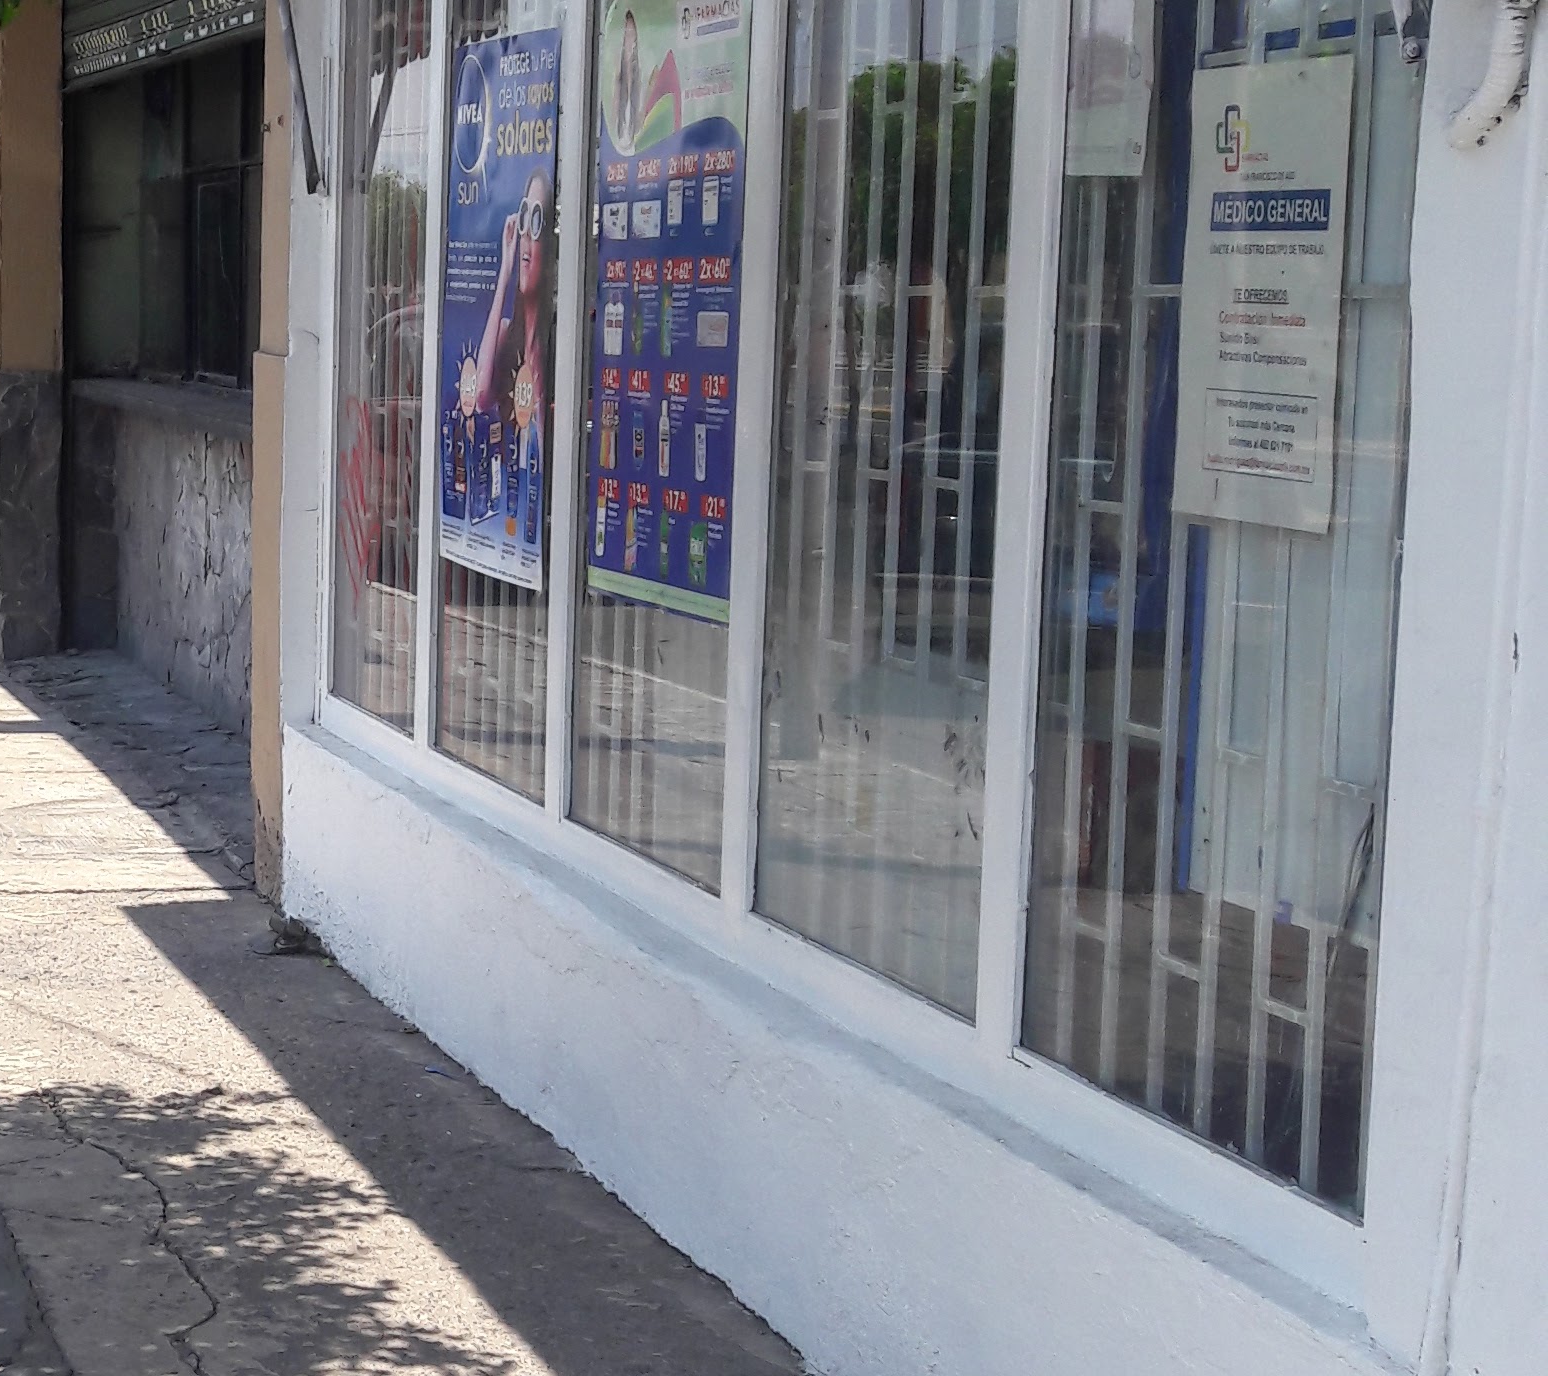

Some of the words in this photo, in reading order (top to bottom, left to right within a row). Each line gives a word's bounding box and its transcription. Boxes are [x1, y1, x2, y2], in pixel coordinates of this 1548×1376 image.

[499, 51, 531, 77] PROTEGE
[540, 48, 557, 70] Piel
[498, 82, 511, 109] de
[513, 80, 527, 107] los
[527, 80, 555, 111] rayos
[457, 101, 484, 125] NIVEA
[496, 110, 554, 158] solares
[457, 180, 480, 205] sun
[1213, 195, 1265, 223] MÉDICO
[1267, 198, 1328, 223] GENERAL
